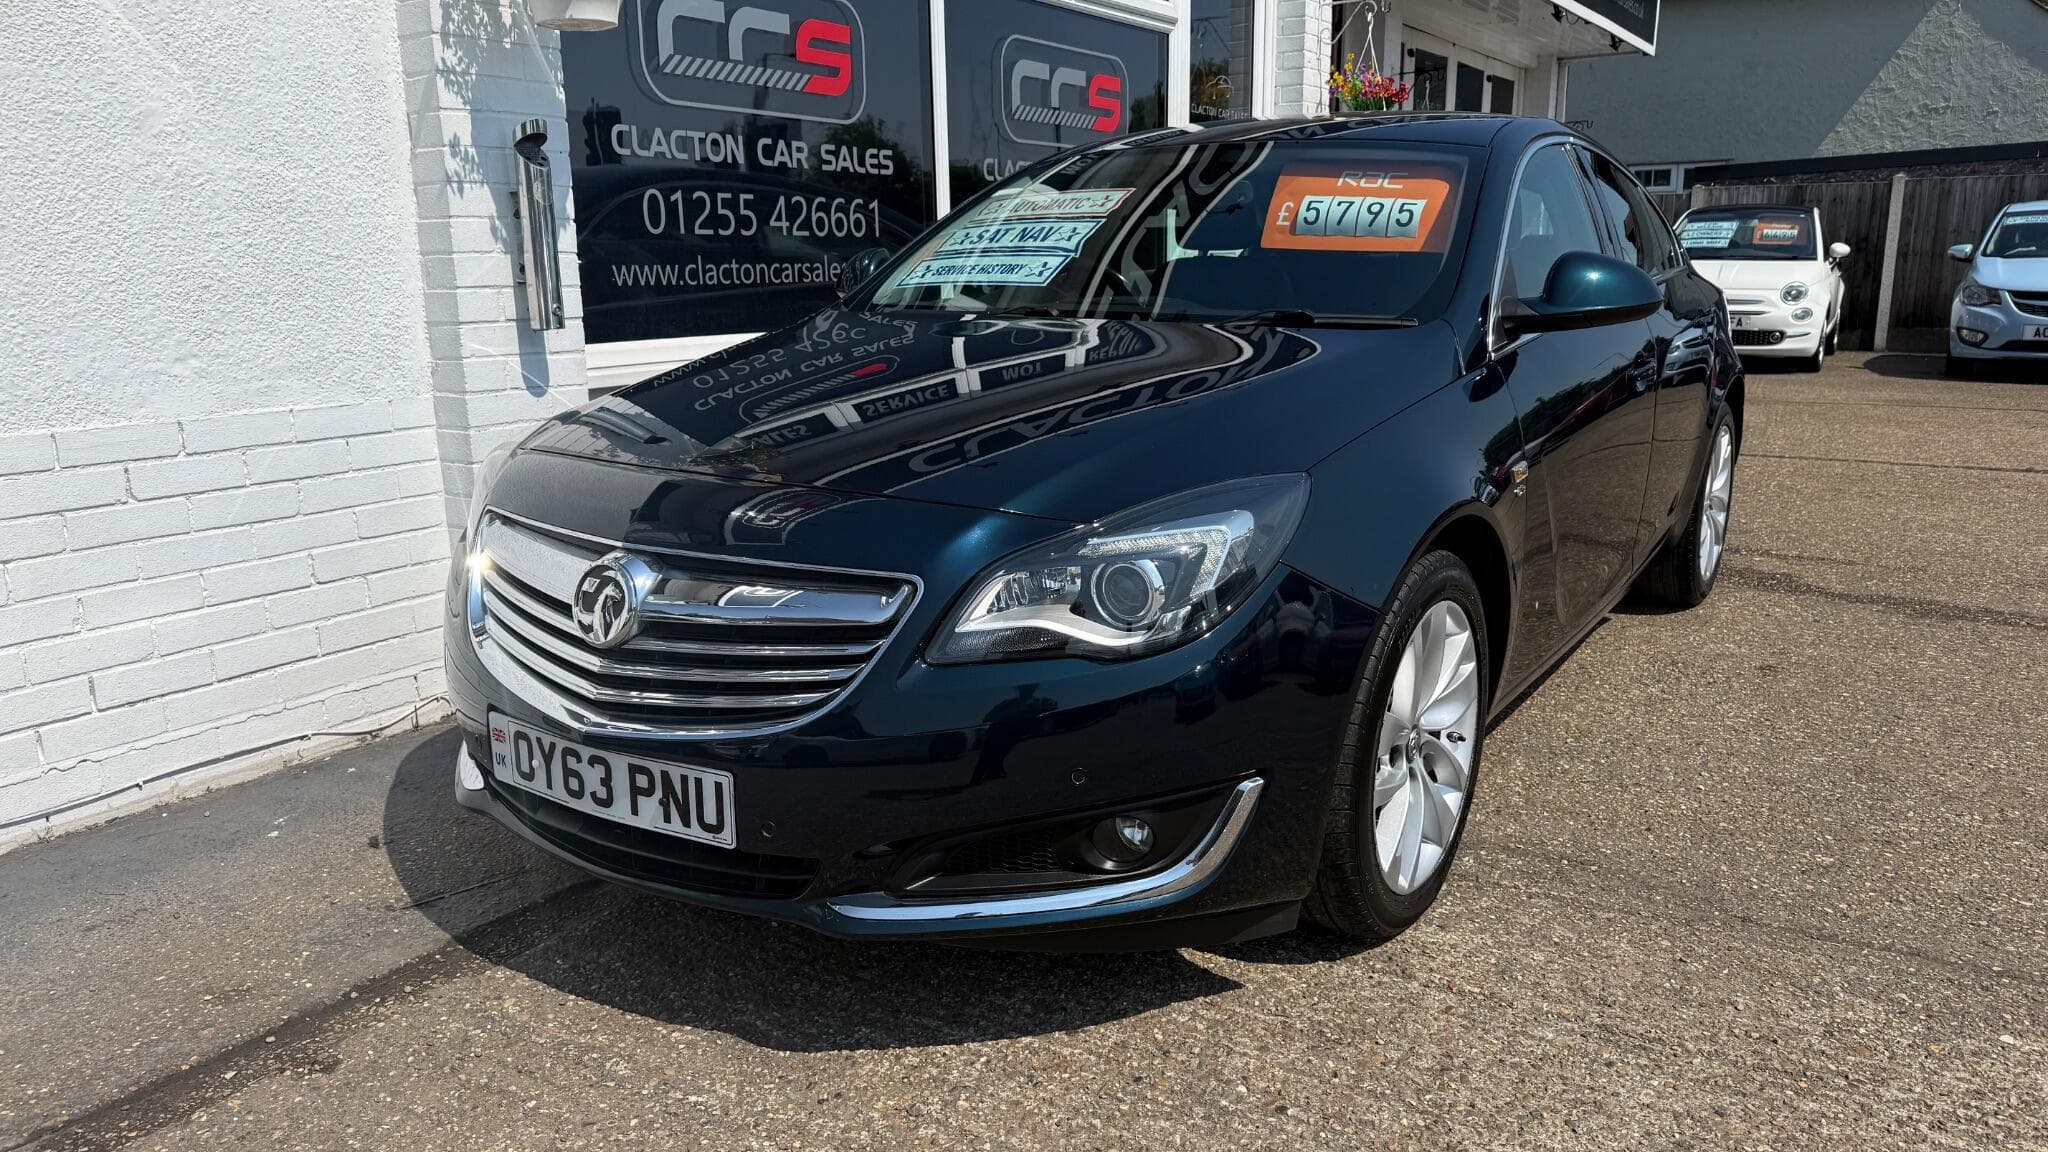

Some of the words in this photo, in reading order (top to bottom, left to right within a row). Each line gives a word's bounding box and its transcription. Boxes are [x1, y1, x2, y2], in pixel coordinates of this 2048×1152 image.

[657, 0, 851, 97] CCS
[1011, 59, 1121, 132] CCS
[611, 124, 744, 164] CLACTON
[757, 138, 809, 169] CAR
[821, 144, 893, 175] SALES
[1337, 171, 1408, 189] RAC
[643, 188, 758, 236] 01255
[769, 195, 881, 238] 426661
[1008, 196, 1091, 214] AUTOMATIC
[969, 226, 1010, 246] SAT
[1011, 225, 1061, 243] NAV
[612, 256, 842, 287] www.clactoncarsale
[931, 262, 978, 276] SERVICE
[979, 262, 1028, 276] HISTORY
[495, 752, 507, 769] UK
[513, 730, 614, 809] OY63
[627, 762, 726, 835] PNU
